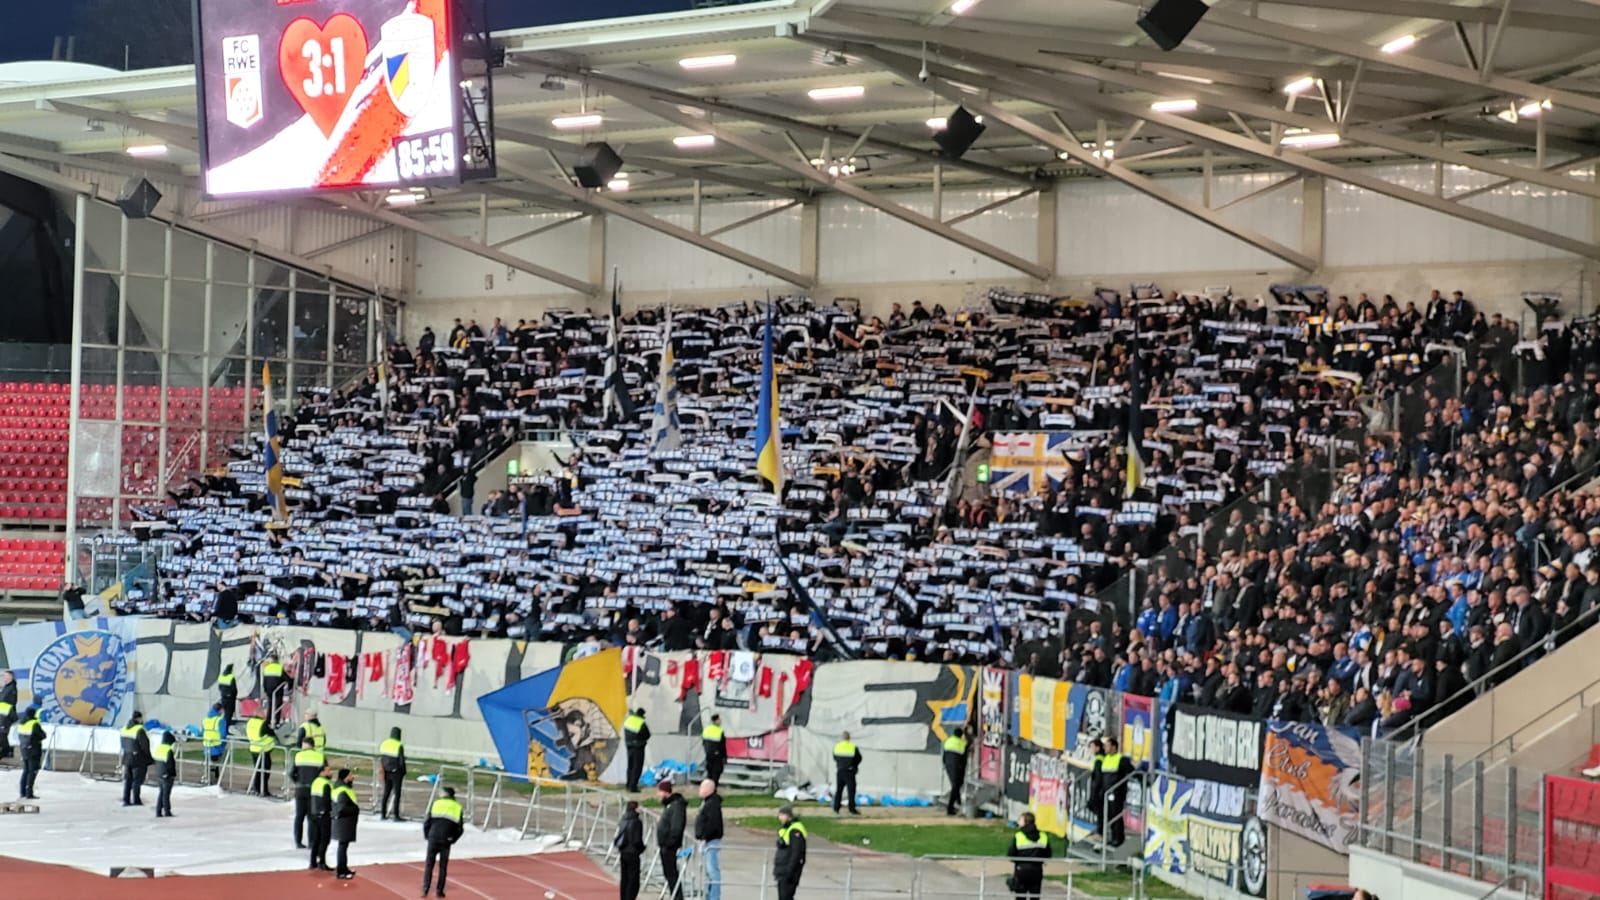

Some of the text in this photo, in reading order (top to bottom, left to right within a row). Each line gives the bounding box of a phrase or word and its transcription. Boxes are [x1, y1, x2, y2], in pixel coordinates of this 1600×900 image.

[232, 39, 250, 55] FC
[227, 55, 256, 71] RWE
[302, 37, 346, 98] 3:1
[397, 132, 455, 178] 85:59
